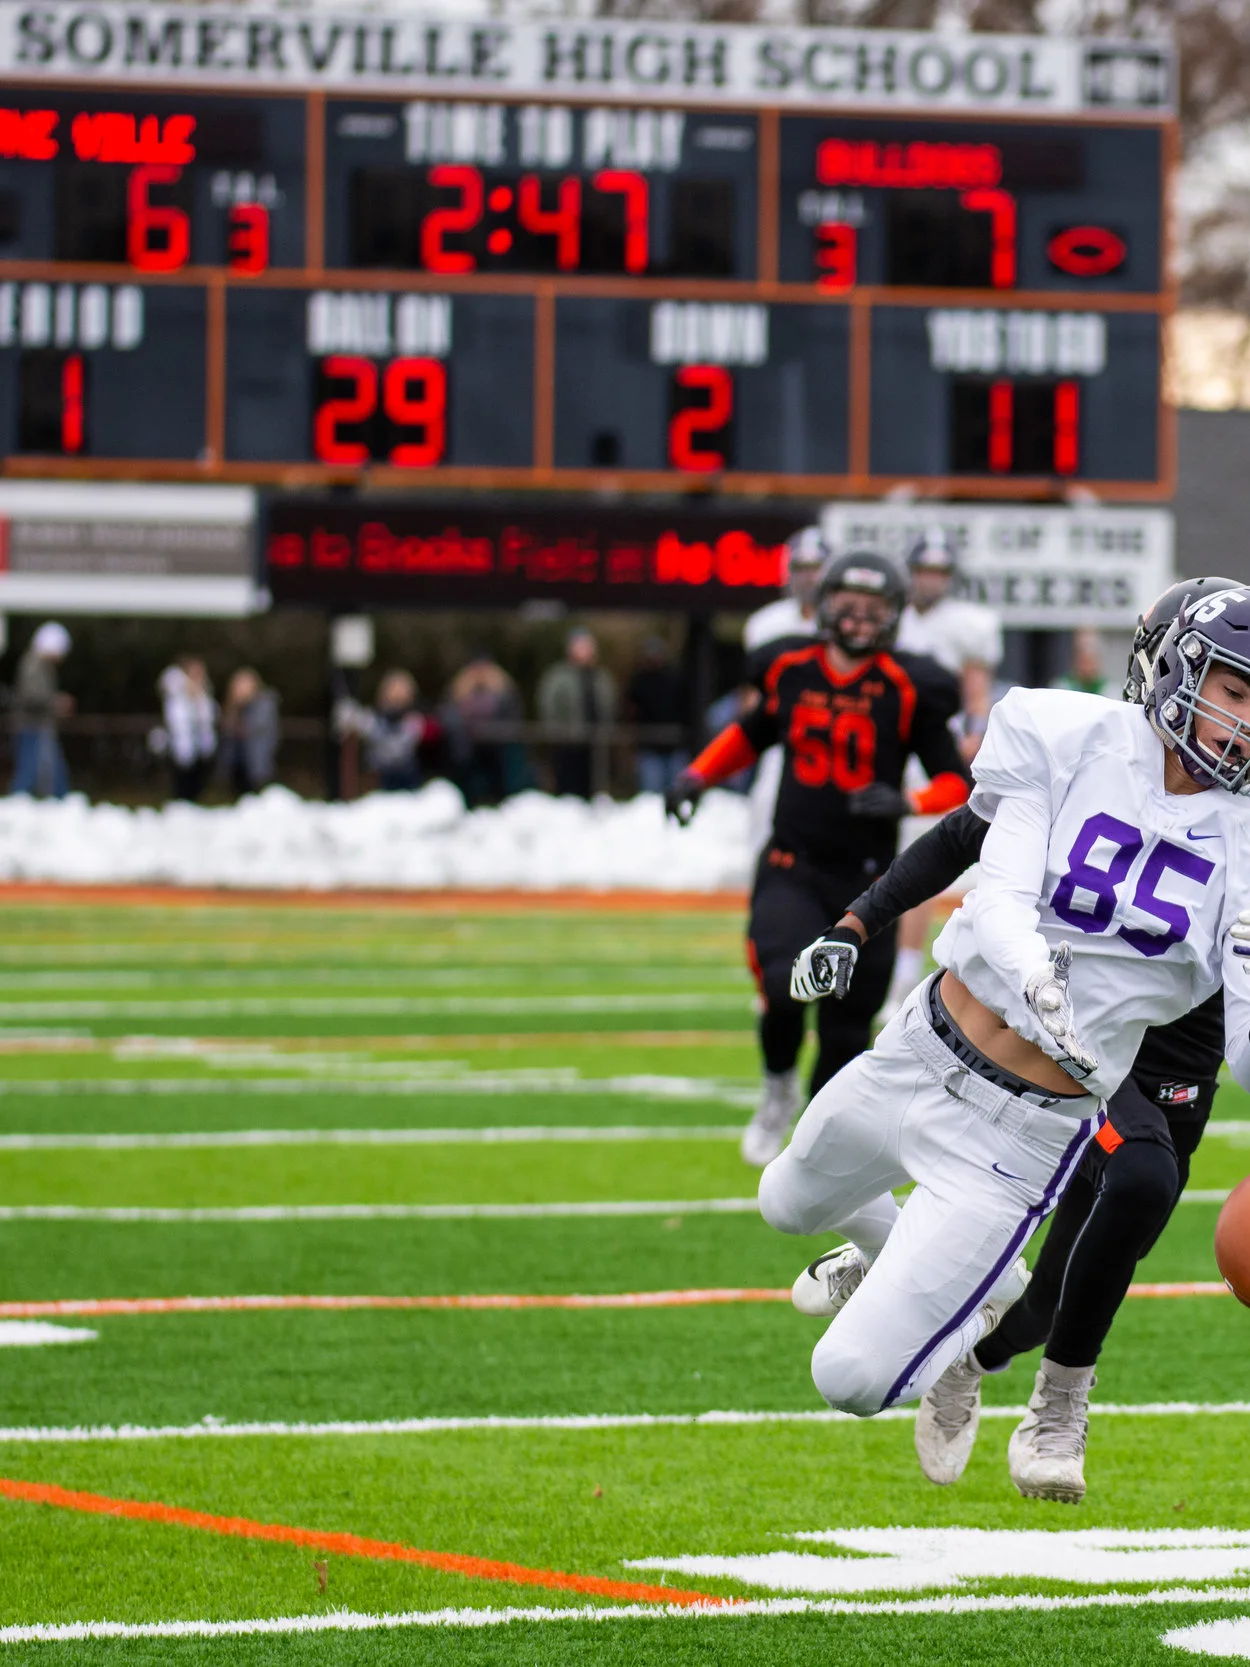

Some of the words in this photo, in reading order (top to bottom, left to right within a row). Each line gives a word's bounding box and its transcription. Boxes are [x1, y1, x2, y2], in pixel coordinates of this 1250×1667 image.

[17, 10, 508, 79] SOMERVILLE
[541, 30, 727, 88] HIGH
[756, 40, 1054, 99] SCHOOL
[404, 101, 507, 164] TIME
[520, 105, 572, 168] TO
[584, 109, 685, 171] PLAY
[128, 163, 190, 272] 6
[230, 203, 268, 278] 3
[420, 164, 648, 274] 2:47
[815, 223, 856, 294] 3
[960, 189, 1015, 290] 7
[651, 303, 769, 365] DOWN
[62, 352, 84, 454] 1
[313, 355, 447, 469] 29
[669, 363, 733, 474] 2
[989, 378, 1080, 475] 11
[789, 703, 876, 794] 50
[1050, 811, 1216, 957] 85
